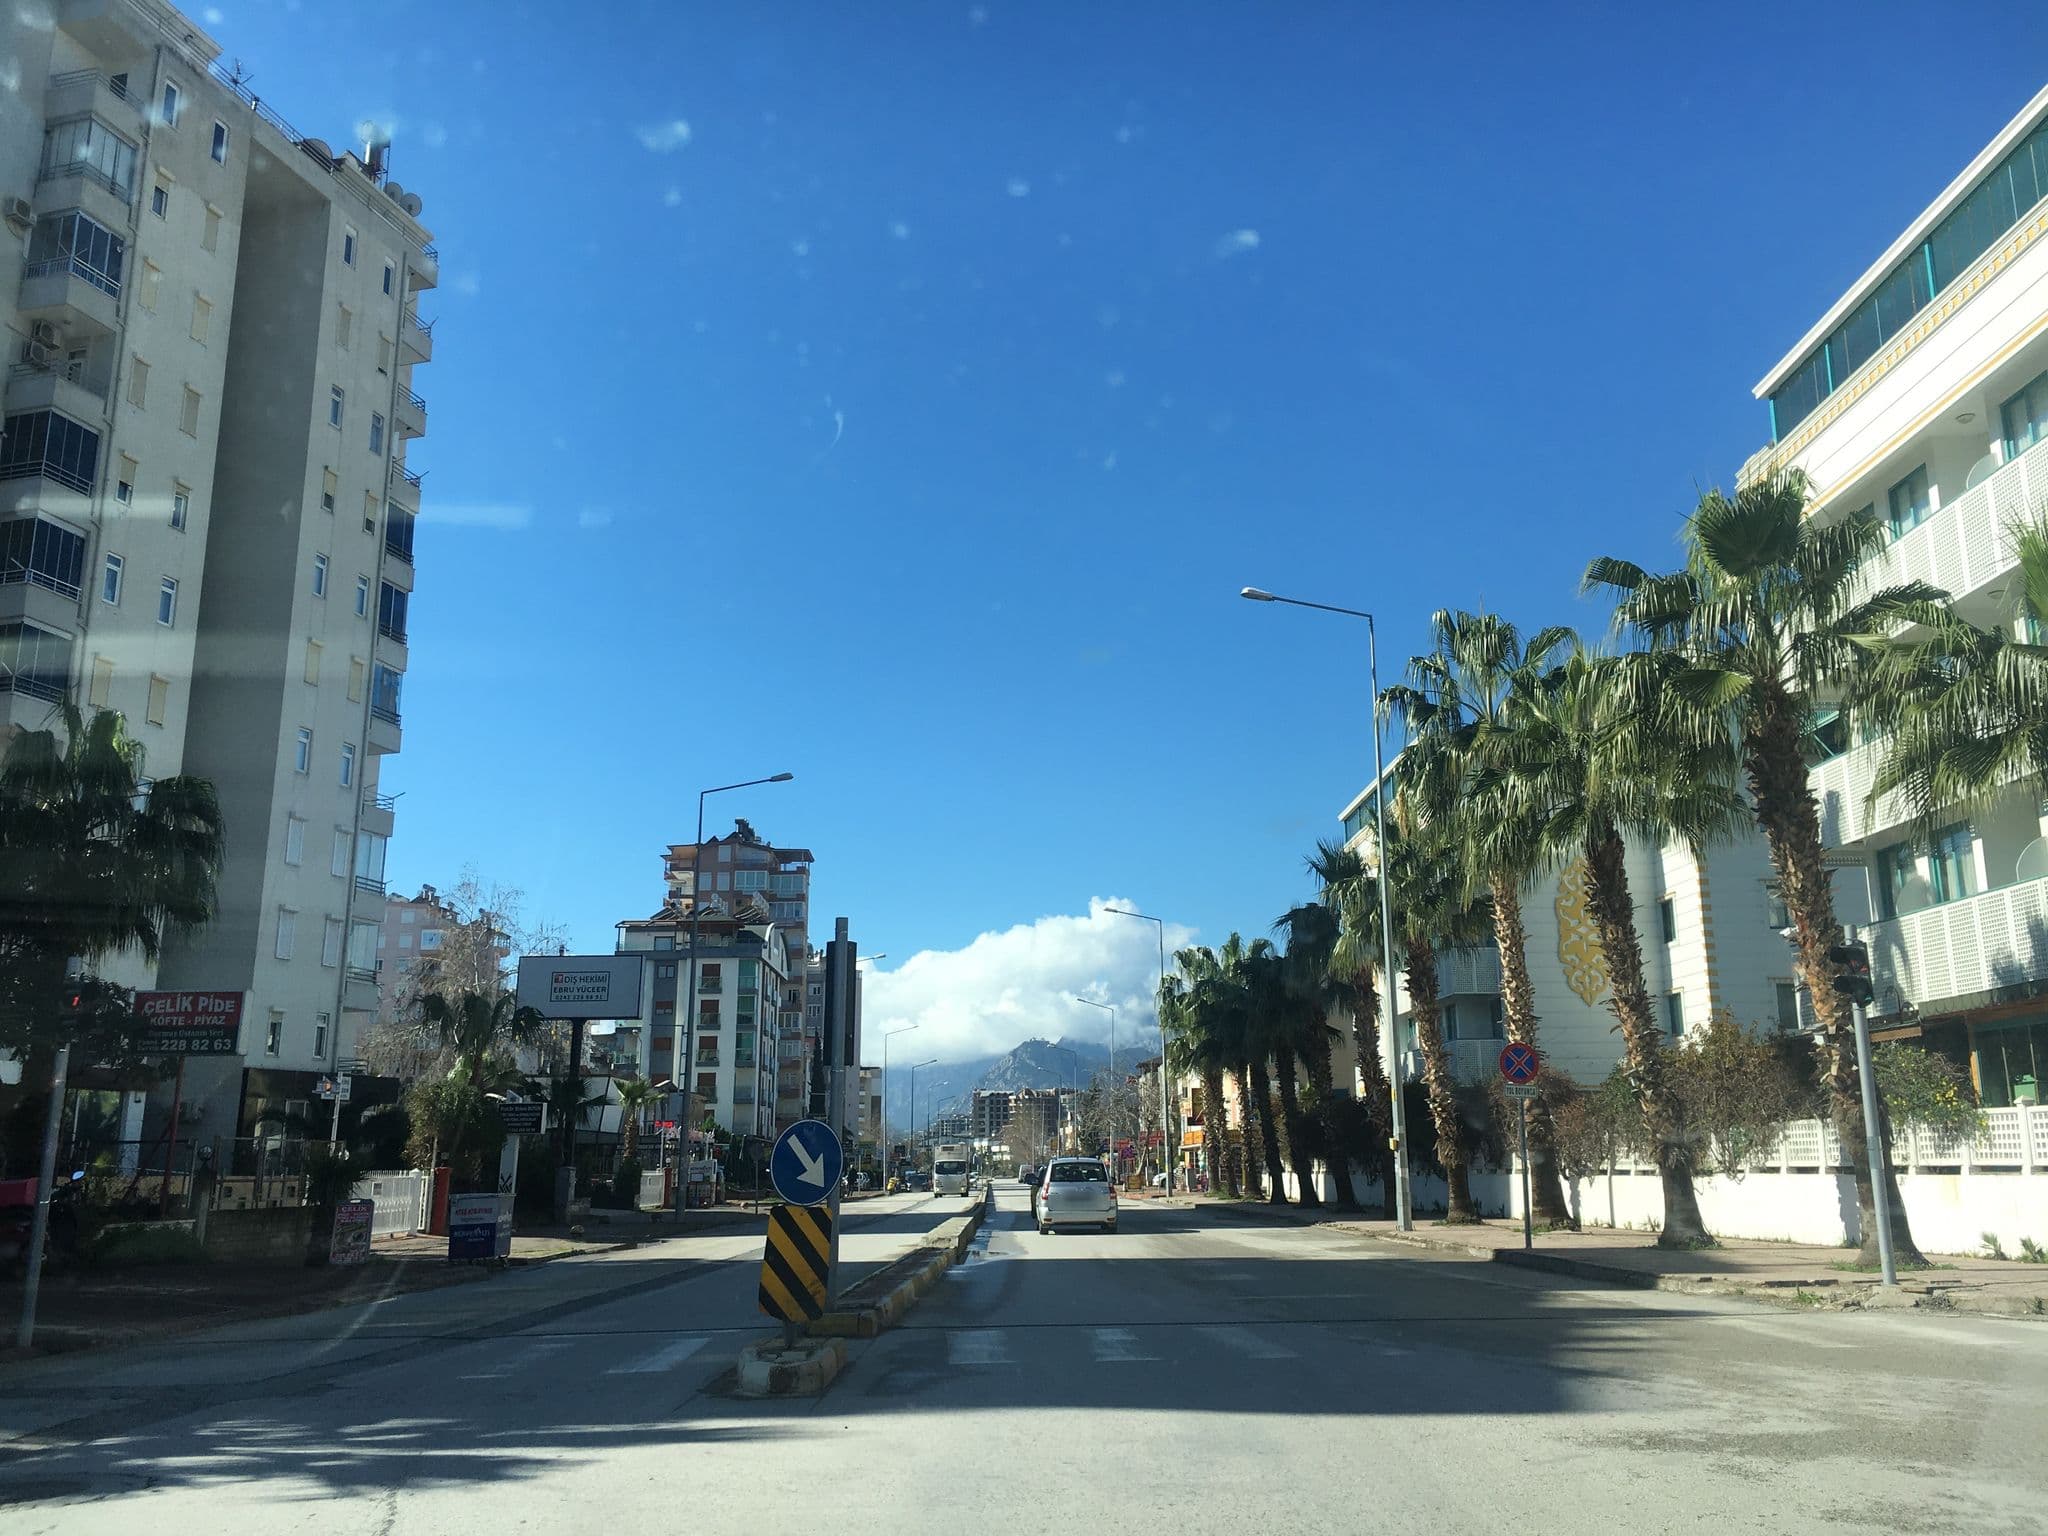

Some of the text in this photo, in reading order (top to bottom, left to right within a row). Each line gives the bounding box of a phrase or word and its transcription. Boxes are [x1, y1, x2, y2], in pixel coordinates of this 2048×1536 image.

[143, 993, 235, 1016] ÇELİK PİDE
[194, 1015, 226, 1026] PİYAZ
[161, 1039, 187, 1051] 228
[191, 1039, 209, 1051] 82
[214, 1038, 232, 1050] 63
